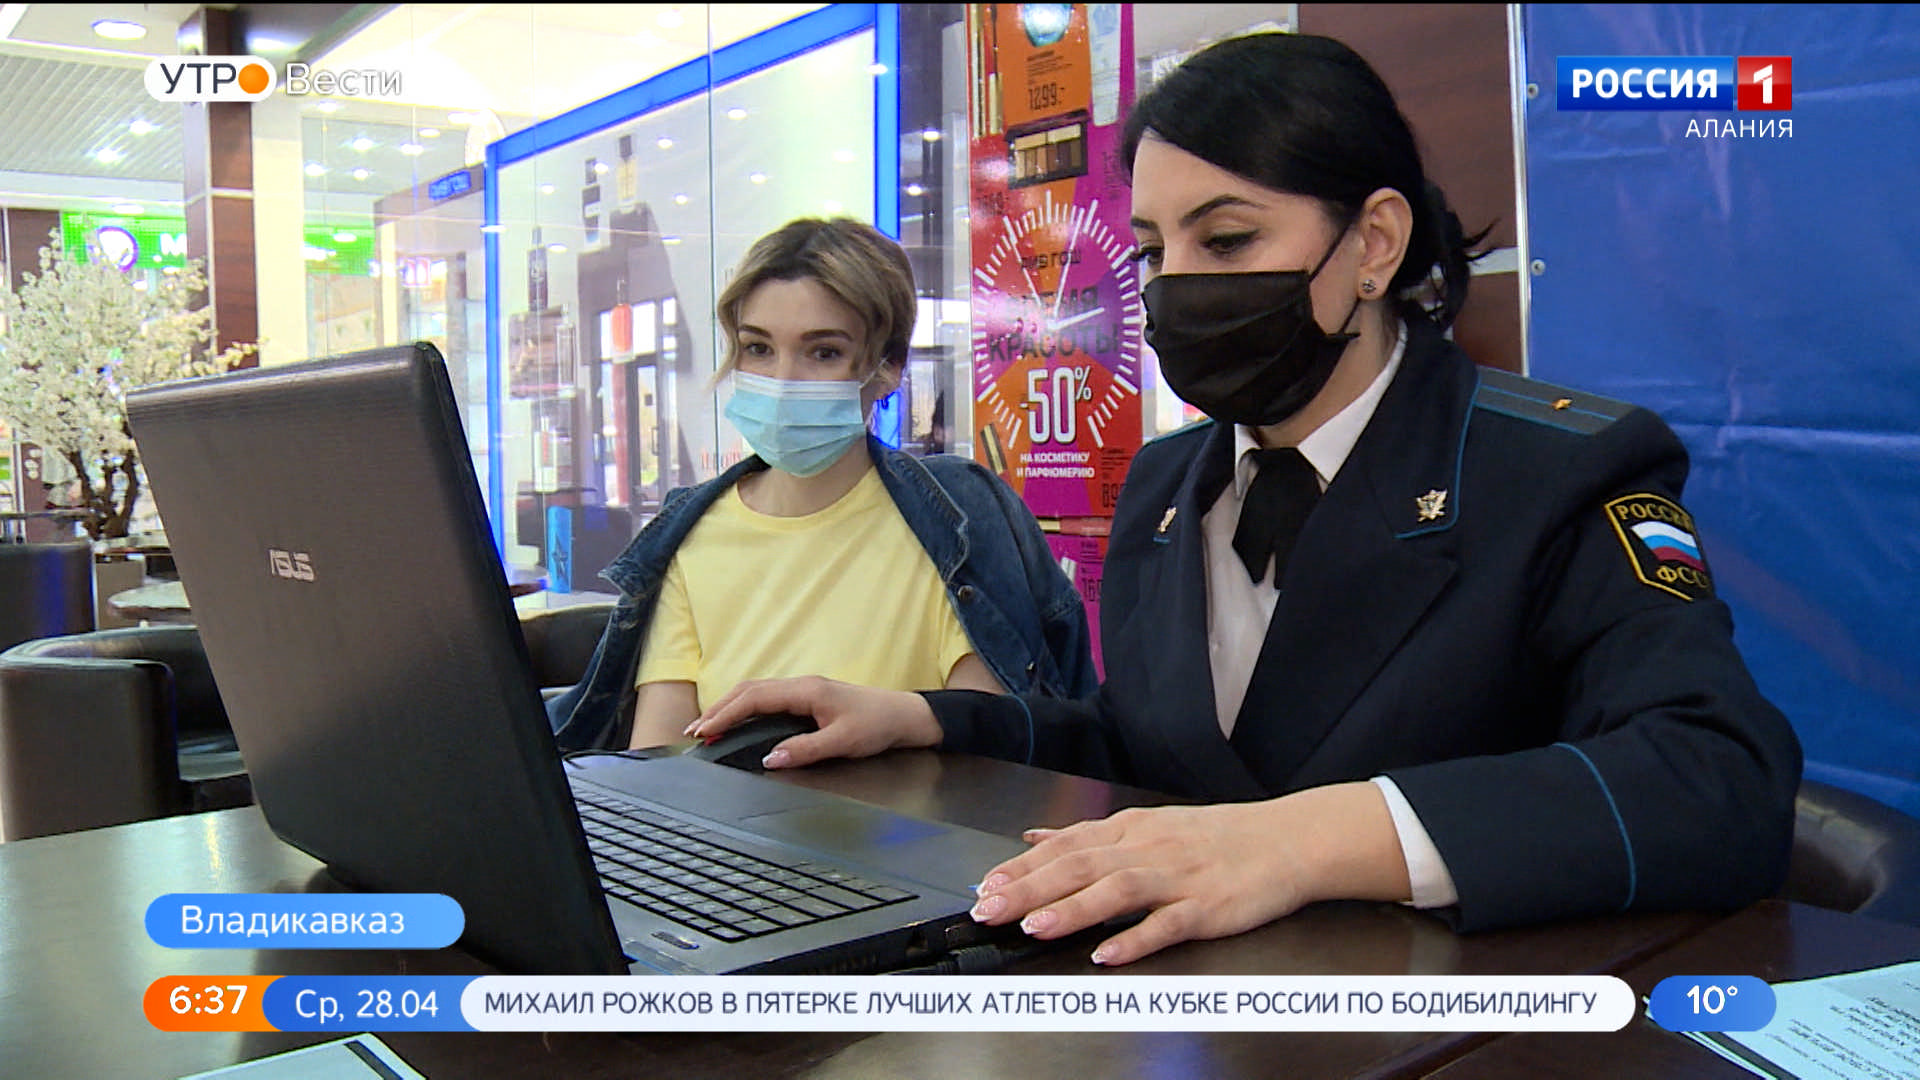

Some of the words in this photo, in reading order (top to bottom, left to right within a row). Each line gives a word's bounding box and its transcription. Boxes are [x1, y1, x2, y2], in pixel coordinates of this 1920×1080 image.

[989, 322, 1119, 362] КРАСОТЫ
[1019, 365, 1092, 443] -50%
[1102, 483, 1127, 509] 89
